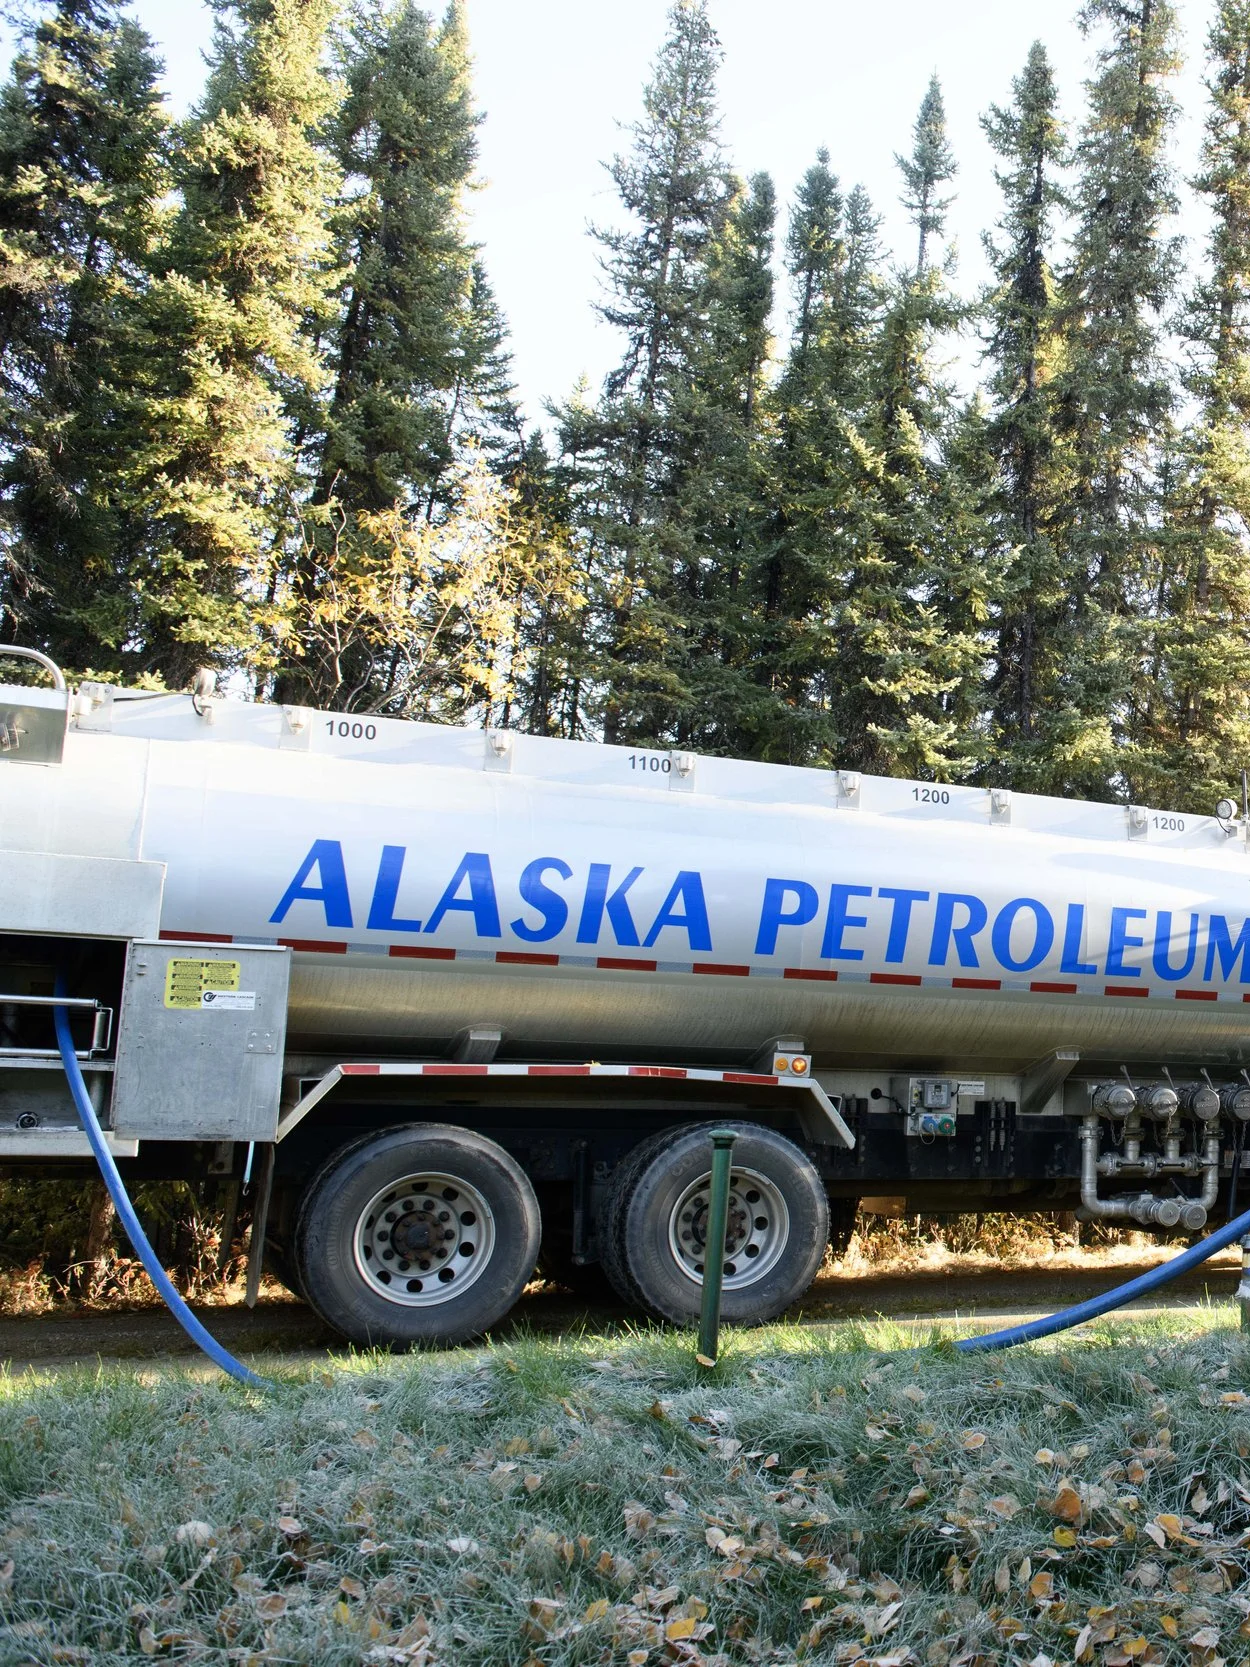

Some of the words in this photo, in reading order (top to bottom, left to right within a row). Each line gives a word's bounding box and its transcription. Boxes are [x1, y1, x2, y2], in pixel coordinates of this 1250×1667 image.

[326, 720, 377, 741] 1000
[628, 755, 671, 774] 1100
[911, 787, 950, 806] 1200
[1151, 816, 1185, 833] 1200
[268, 839, 713, 951] ALASKA
